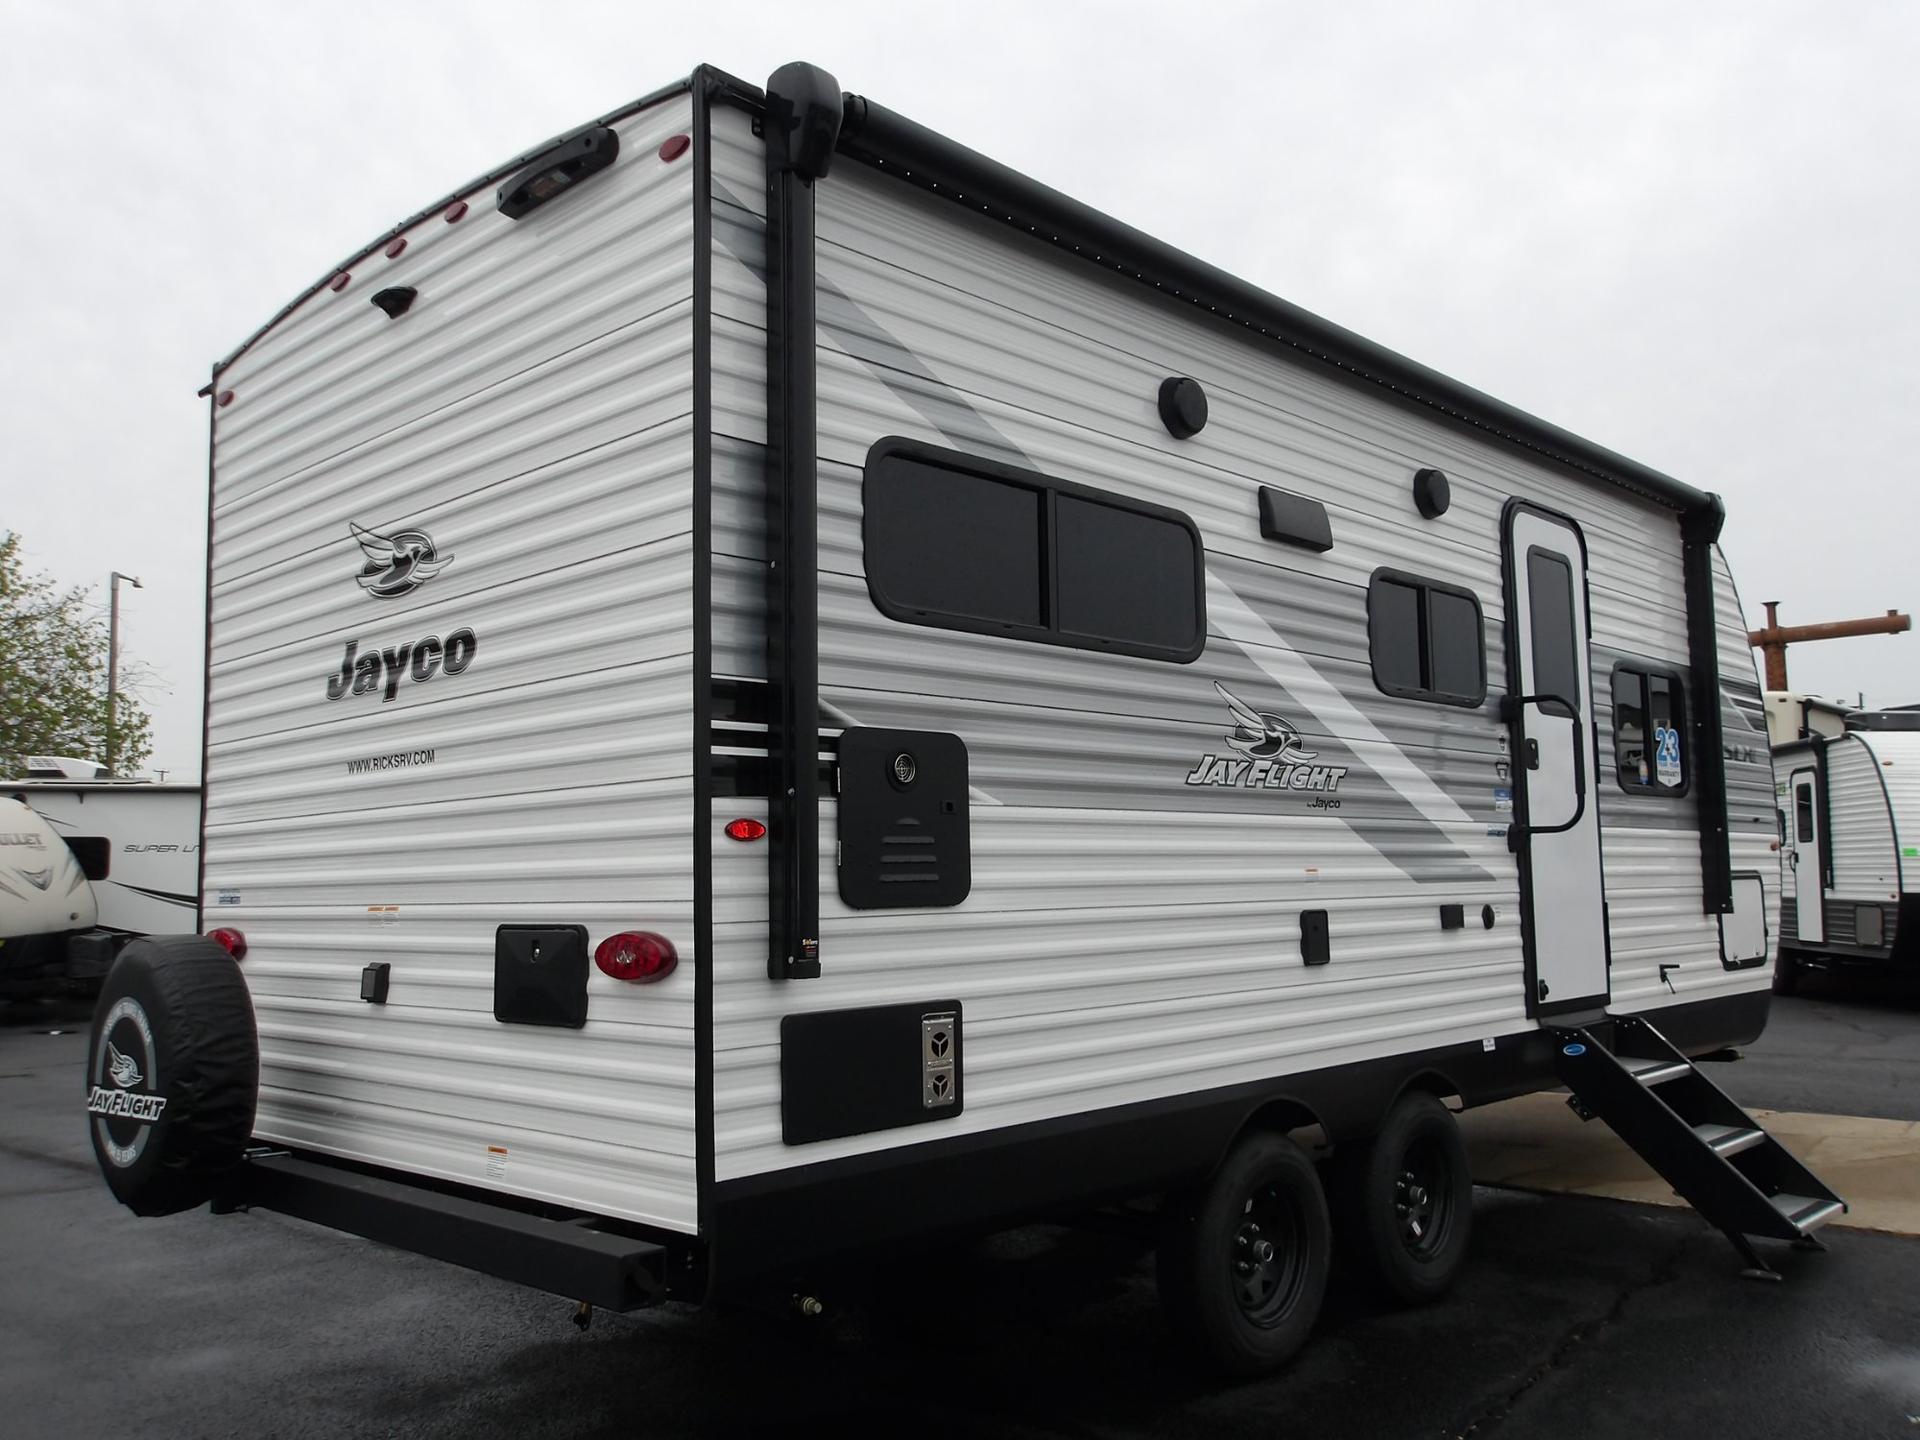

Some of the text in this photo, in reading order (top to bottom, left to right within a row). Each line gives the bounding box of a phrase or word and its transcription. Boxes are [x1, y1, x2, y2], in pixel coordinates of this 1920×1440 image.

[325, 626, 478, 703] Jayco
[347, 749, 435, 775] WWW.RICKSRV.COM
[123, 844, 179, 853] SUPER
